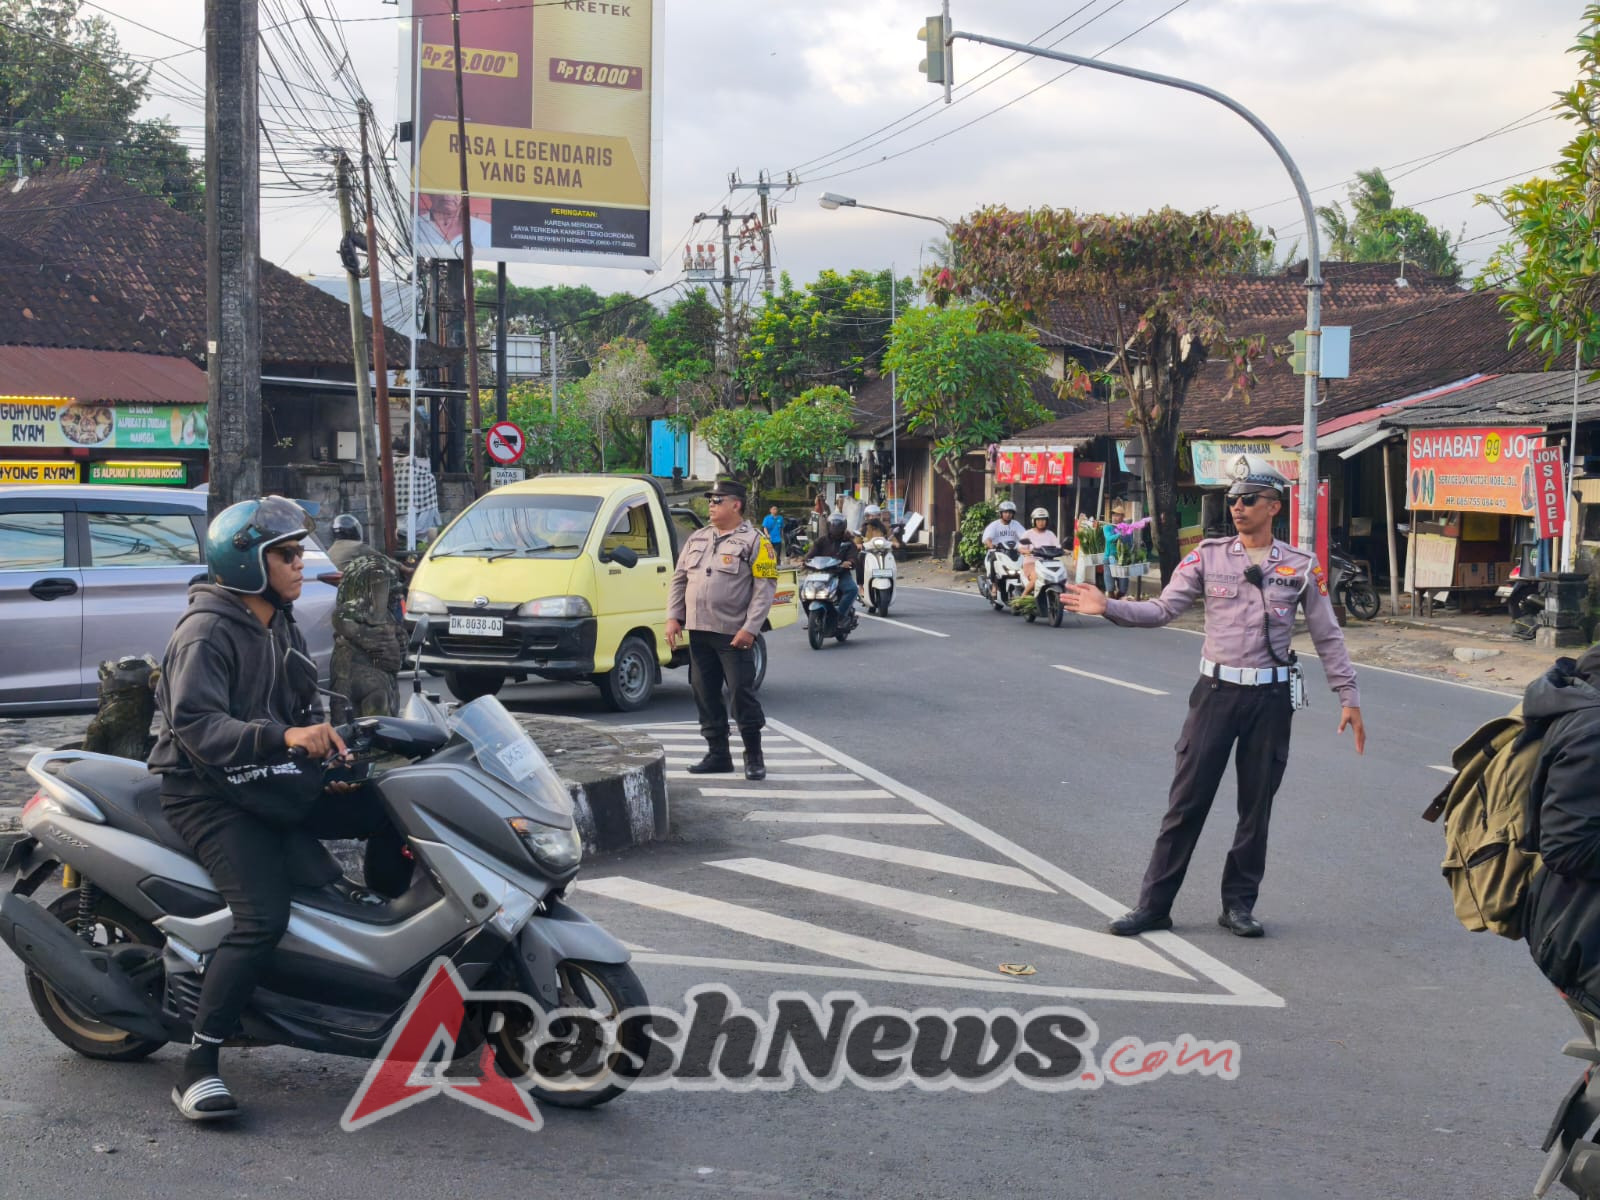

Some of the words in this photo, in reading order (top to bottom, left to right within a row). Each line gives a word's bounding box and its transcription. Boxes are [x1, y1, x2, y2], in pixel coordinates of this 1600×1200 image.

[564, 0, 632, 17] KRETEK
[449, 134, 497, 157] RASA
[504, 138, 613, 167] LEGENDARIS
[479, 161, 526, 184] YANG
[533, 165, 583, 188] SAMA
[530, 226, 560, 235] TERKENA
[544, 219, 570, 227] KARENA
[0, 403, 57, 421] GOHYONG
[12, 424, 45, 442] AYAM
[1412, 435, 1483, 459] SAHABAT
[1485, 439, 1500, 457] 99
[1504, 434, 1539, 459] JOK
[1535, 449, 1558, 464] JOK
[43, 466, 76, 480] AYAM
[101, 467, 129, 479] ALPUKAT
[1542, 464, 1559, 534] SADEL
[227, 767, 268, 785] HAPPY
